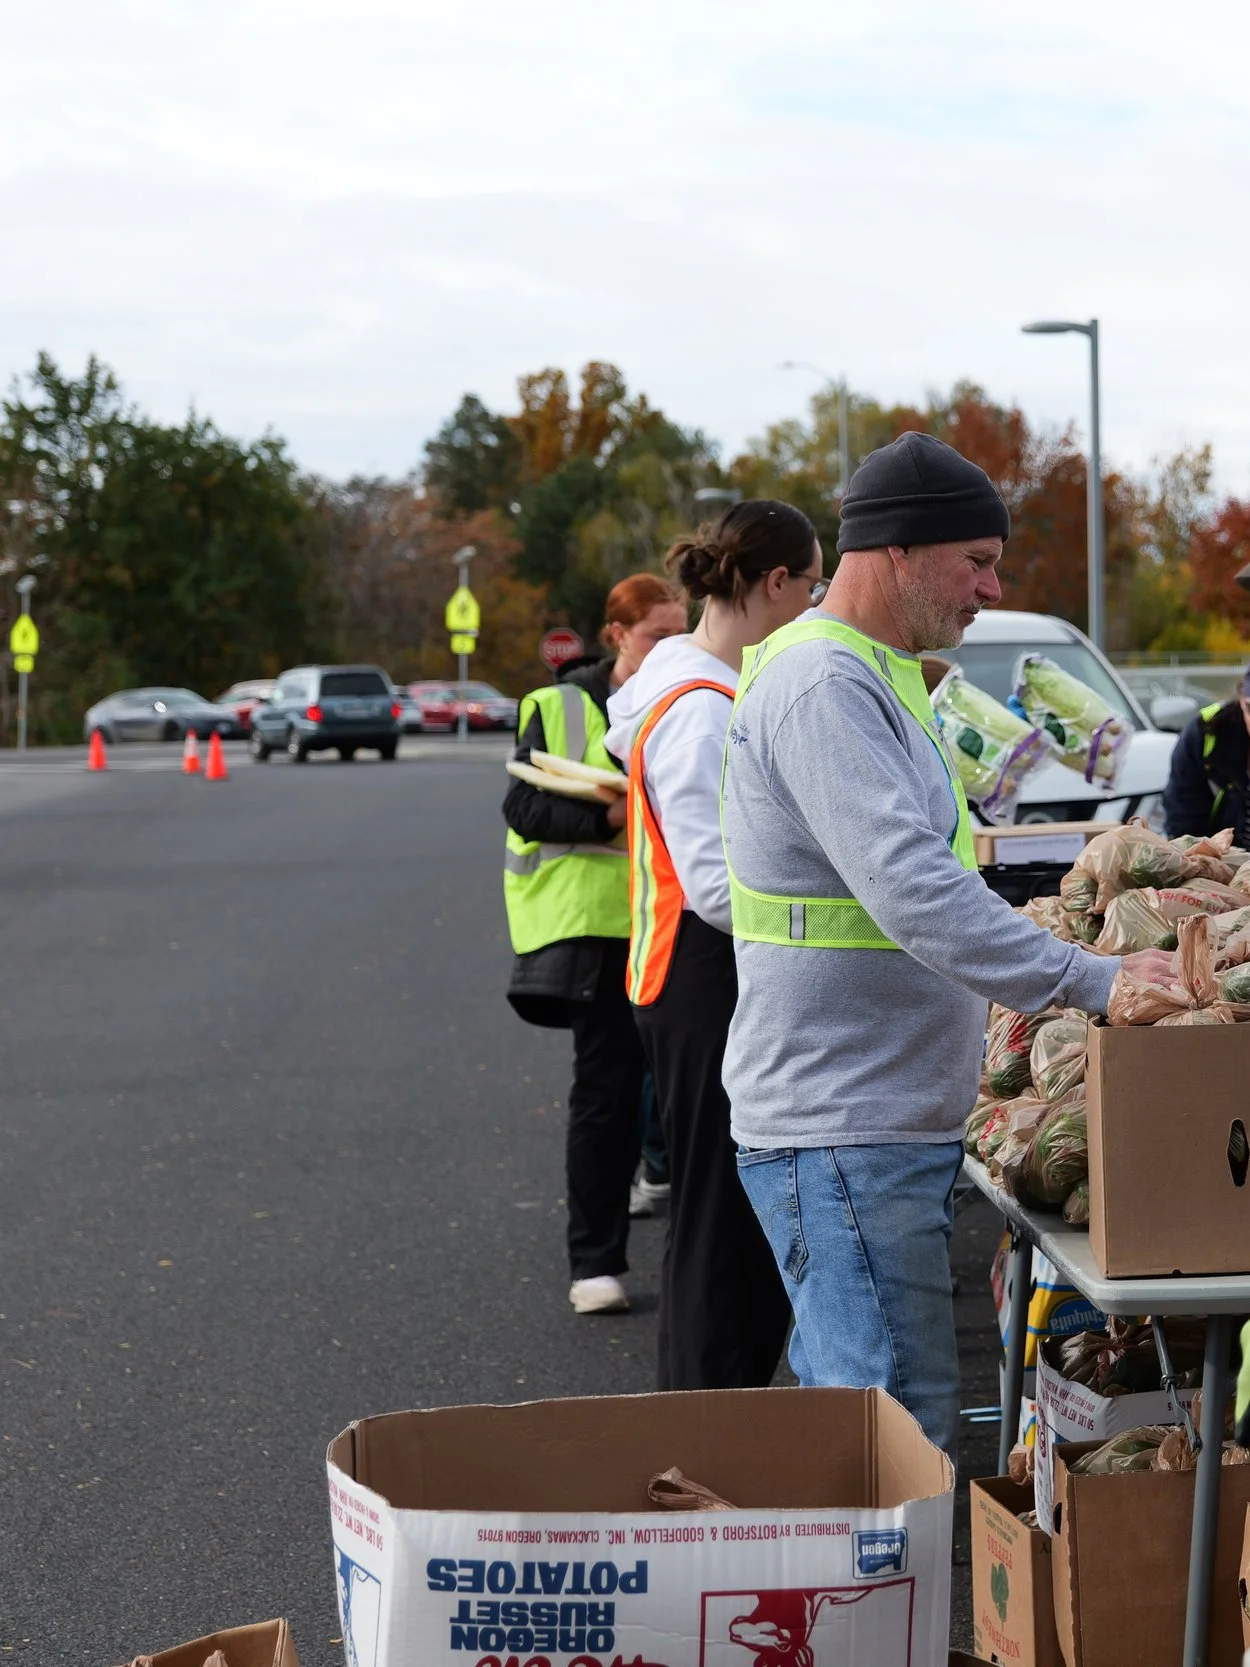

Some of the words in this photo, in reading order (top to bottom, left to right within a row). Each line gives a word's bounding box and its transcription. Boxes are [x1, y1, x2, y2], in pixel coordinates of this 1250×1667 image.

[543, 641, 580, 660] STOP
[1180, 895, 1203, 909] FOR
[353, 1517, 364, 1538] NET
[477, 1528, 504, 1542] 97015
[544, 1528, 600, 1544] CLACKAMAS,
[630, 1526, 705, 1544] GOODFELLOW,
[710, 1526, 718, 1541] &
[722, 1524, 778, 1542] BOTSFORD
[779, 1523, 791, 1538] BY
[795, 1522, 851, 1537] DISTRIBUTED
[376, 1533, 383, 1551] 50
[505, 1529, 541, 1544] OREGON
[605, 1528, 626, 1545] INC.
[861, 1542, 902, 1558] Oregon
[426, 1558, 648, 1595] POTATOES
[450, 1599, 616, 1627] RUSSET
[450, 1624, 616, 1653] OREGON
